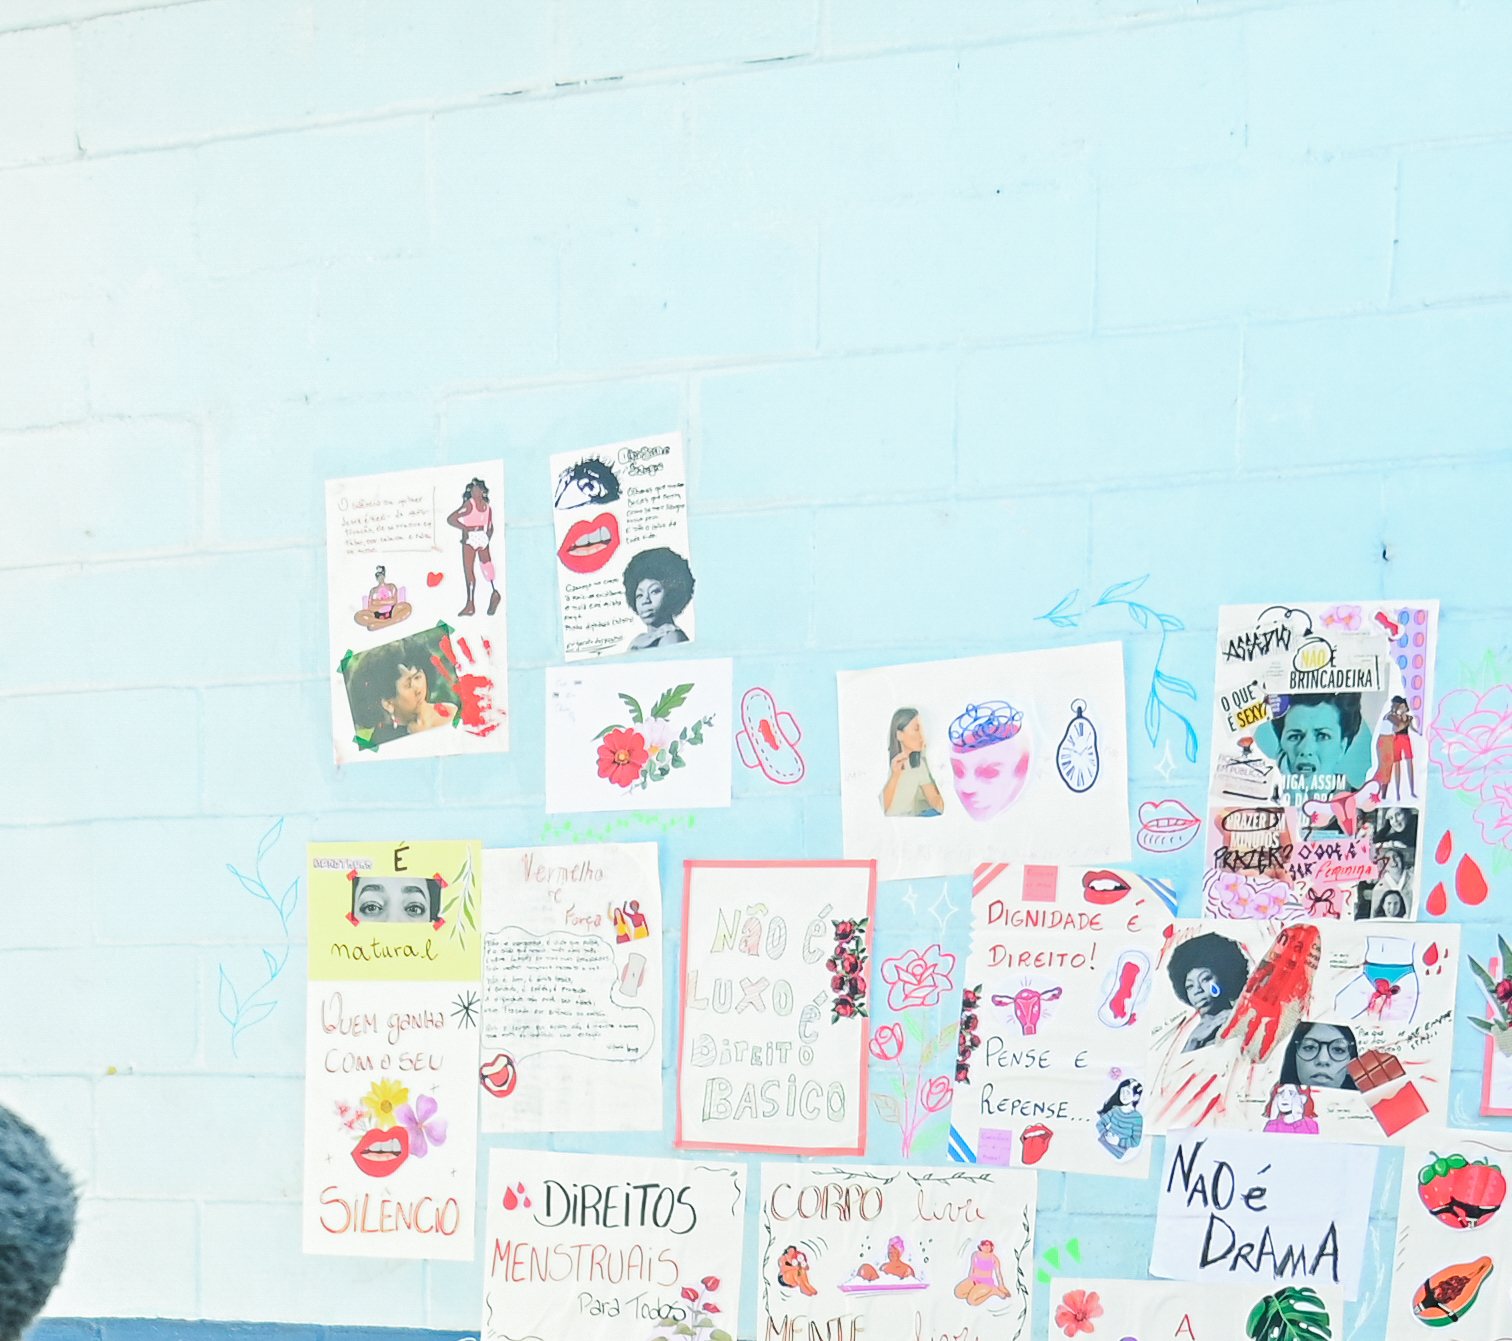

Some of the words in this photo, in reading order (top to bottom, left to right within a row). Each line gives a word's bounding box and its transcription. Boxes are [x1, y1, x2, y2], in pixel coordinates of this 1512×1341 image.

[1289, 669, 1373, 690] BRINCADEIRA
[1231, 684, 1257, 710] QUE
[988, 899, 1103, 932] DIGNIDADE
[331, 937, 439, 961] natural
[988, 941, 1097, 971] DIREITO!
[687, 969, 794, 1016] LUXO
[399, 1051, 444, 1072] SEU
[984, 1036, 1051, 1069] PENSE
[770, 1181, 884, 1223] CORPO
[1175, 1313, 1197, 1341] A
